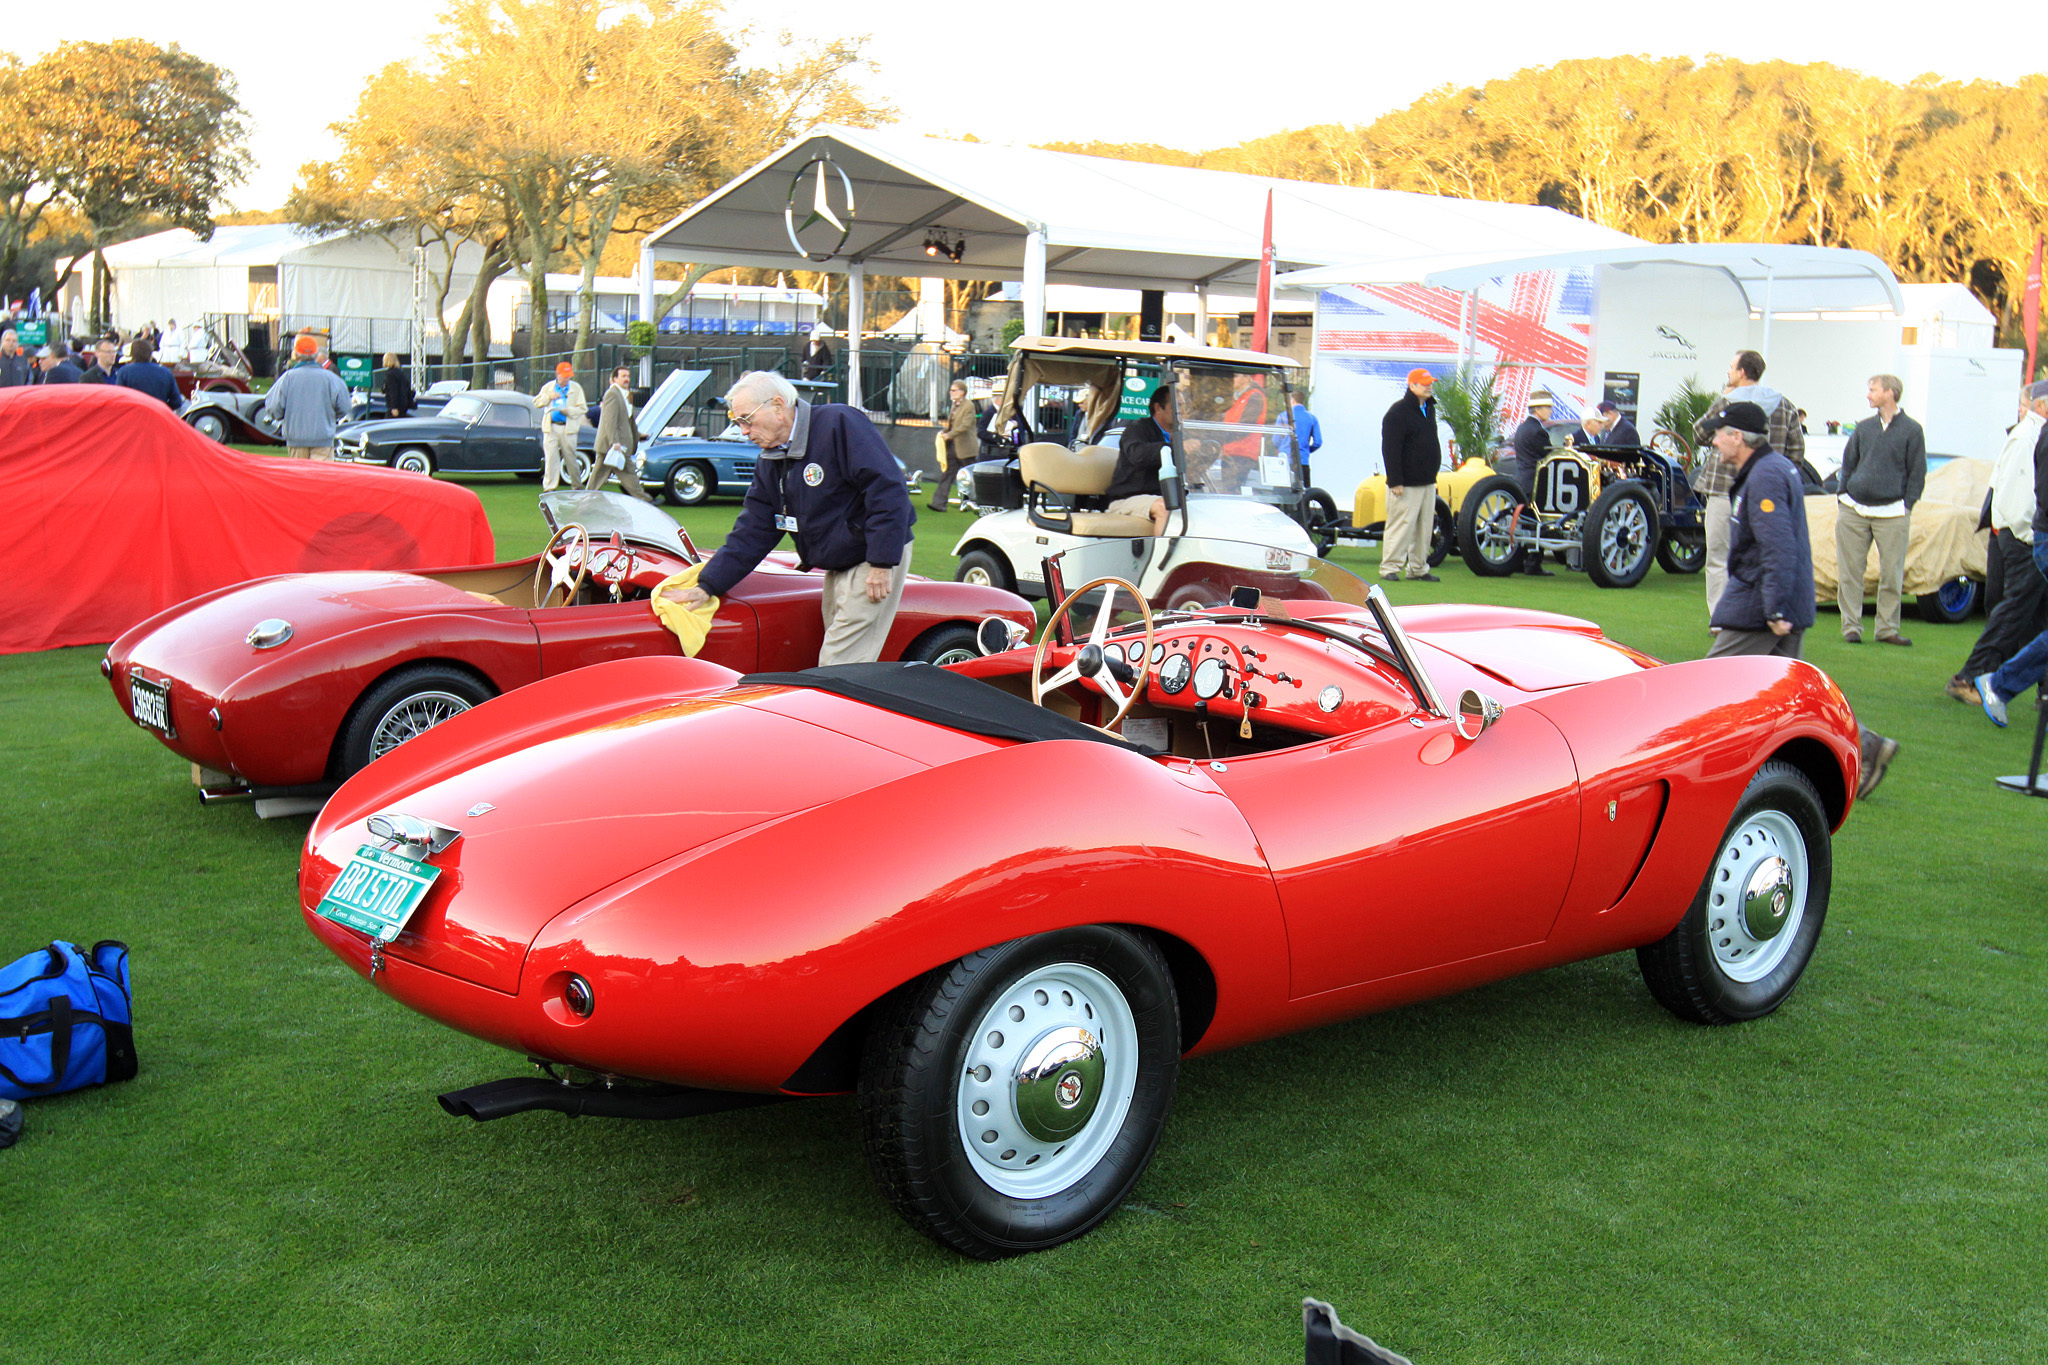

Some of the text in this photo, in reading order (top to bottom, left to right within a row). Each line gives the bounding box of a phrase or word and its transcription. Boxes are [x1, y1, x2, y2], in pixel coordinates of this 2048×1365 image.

[1647, 350, 1697, 361] JAGUAR
[1120, 395, 1135, 405] ACE
[1120, 406, 1148, 415] PRE-WAR
[1543, 460, 1580, 513] 16
[131, 684, 157, 726] C9692
[378, 851, 415, 873] Vermont
[332, 861, 415, 920] BRISTOL
[335, 909, 379, 931] Green Mountain State
